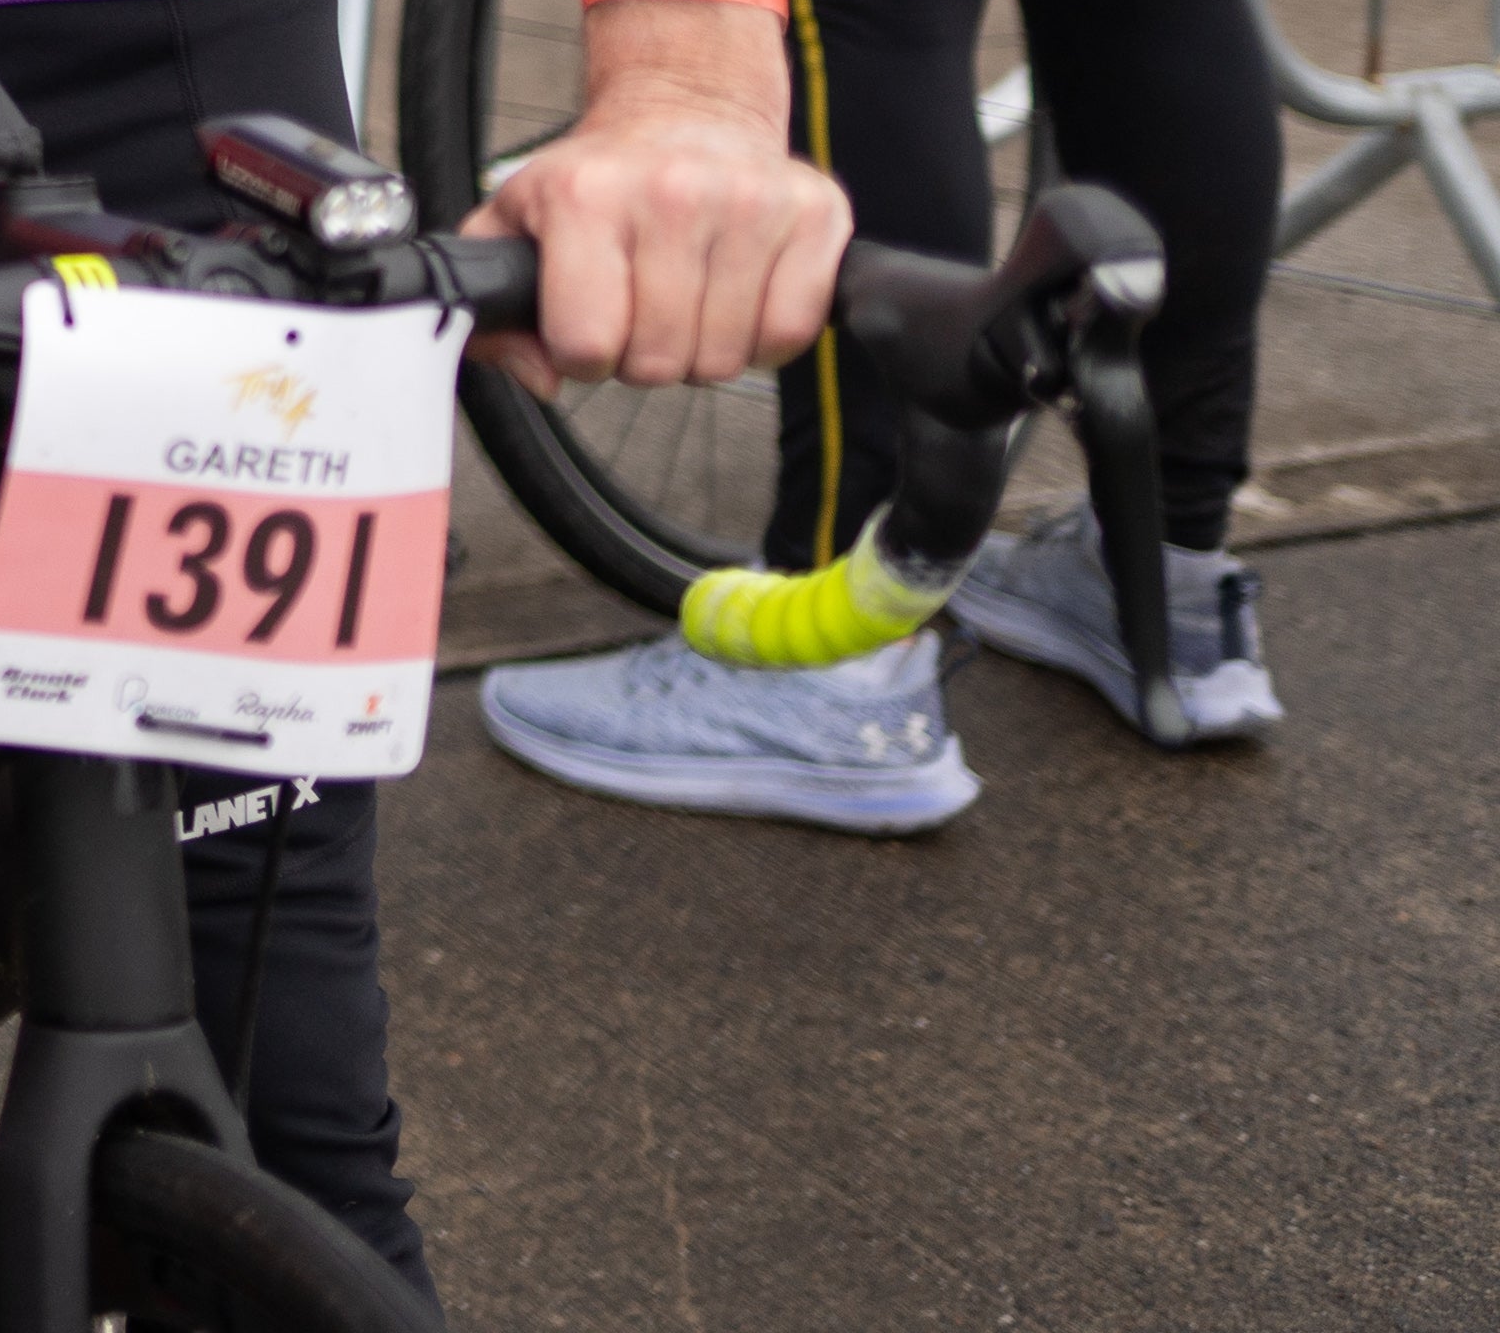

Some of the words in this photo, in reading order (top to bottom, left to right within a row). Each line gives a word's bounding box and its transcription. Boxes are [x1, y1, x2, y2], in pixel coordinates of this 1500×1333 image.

[163, 439, 350, 486] GARETH
[81, 493, 377, 649] 1391
[174, 783, 281, 842] LANET
[292, 774, 321, 811] X
